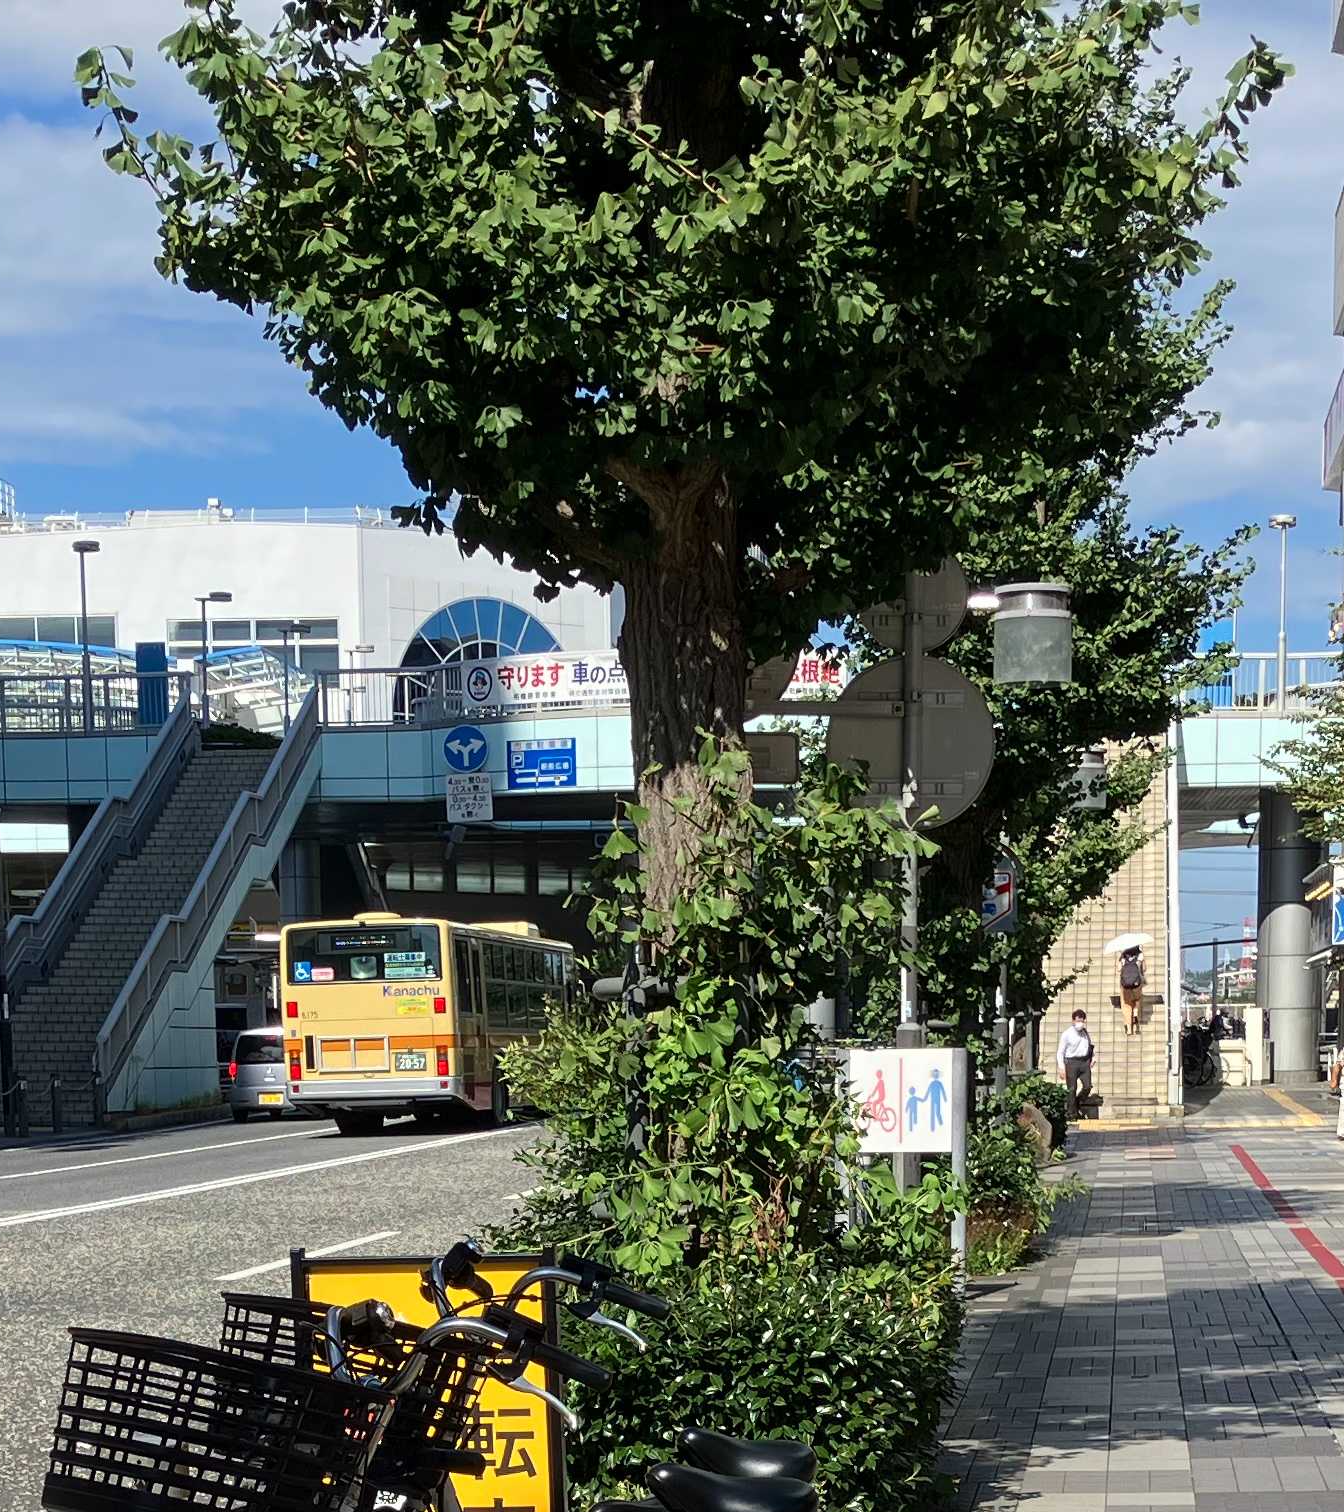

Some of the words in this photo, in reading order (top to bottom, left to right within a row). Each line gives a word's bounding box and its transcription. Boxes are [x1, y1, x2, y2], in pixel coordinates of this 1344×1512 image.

[497, 662, 564, 690] 守ります
[572, 659, 626, 686] 車の点
[513, 755, 523, 765] P
[383, 985, 440, 998] Kanachu
[400, 1058, 425, 1069] 20-57
